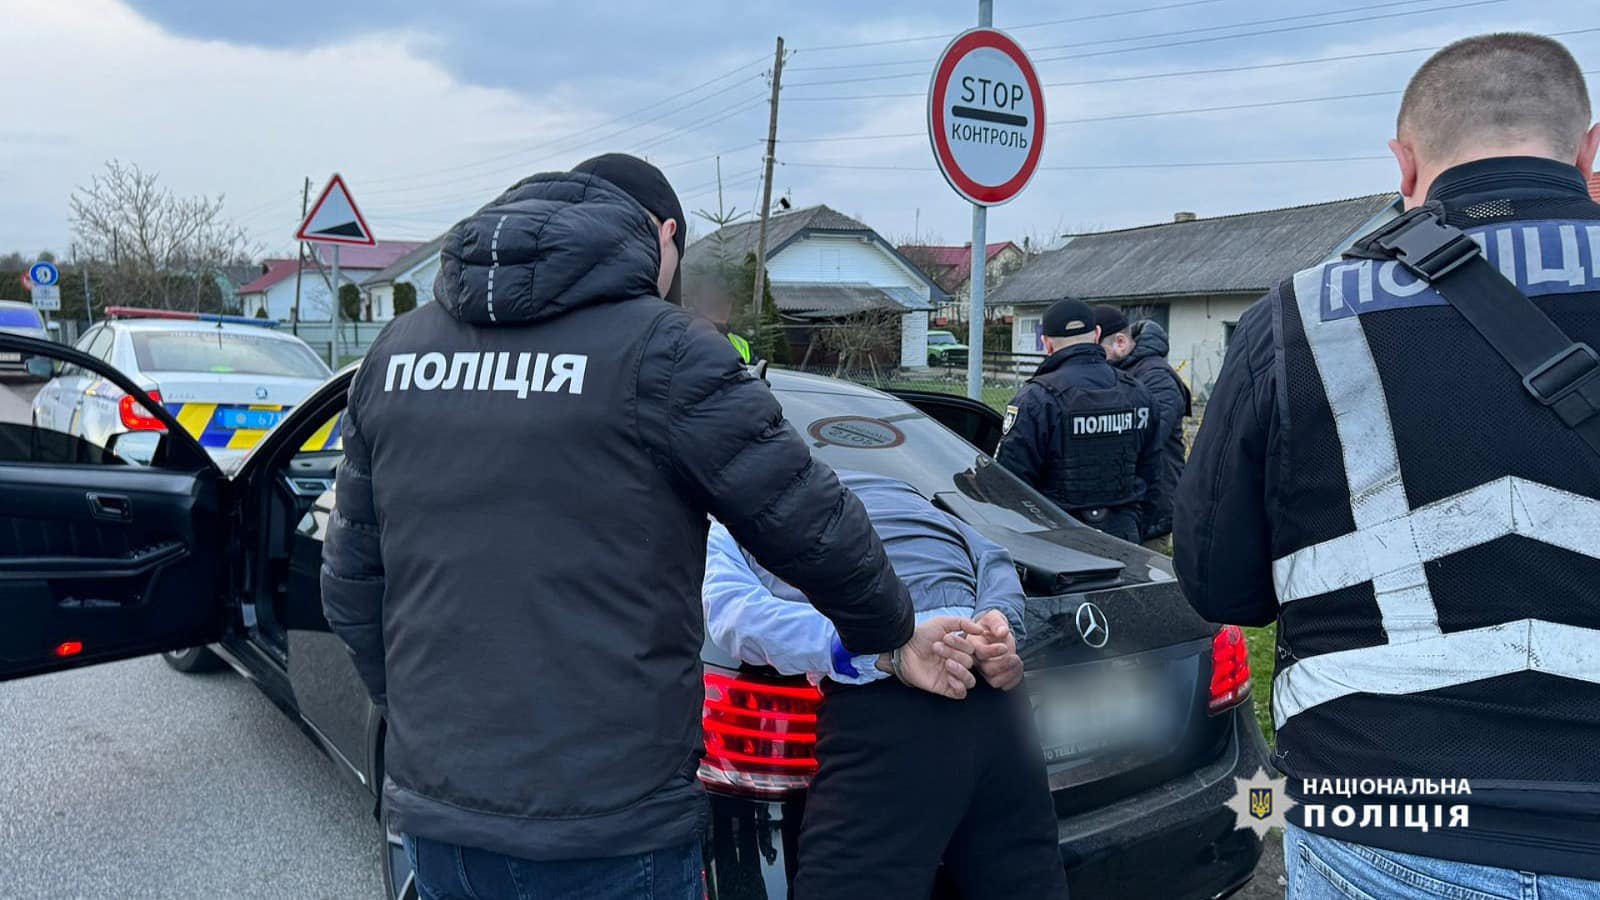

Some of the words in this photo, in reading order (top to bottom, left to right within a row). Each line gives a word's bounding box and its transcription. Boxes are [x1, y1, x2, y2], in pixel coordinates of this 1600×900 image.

[961, 76, 1023, 111] STOP
[952, 123, 1028, 149] КОНТРОЛЬ
[384, 352, 588, 399] ПОЛІЦІЯ
[1073, 412, 1133, 434] ПОЛІЦІЯ
